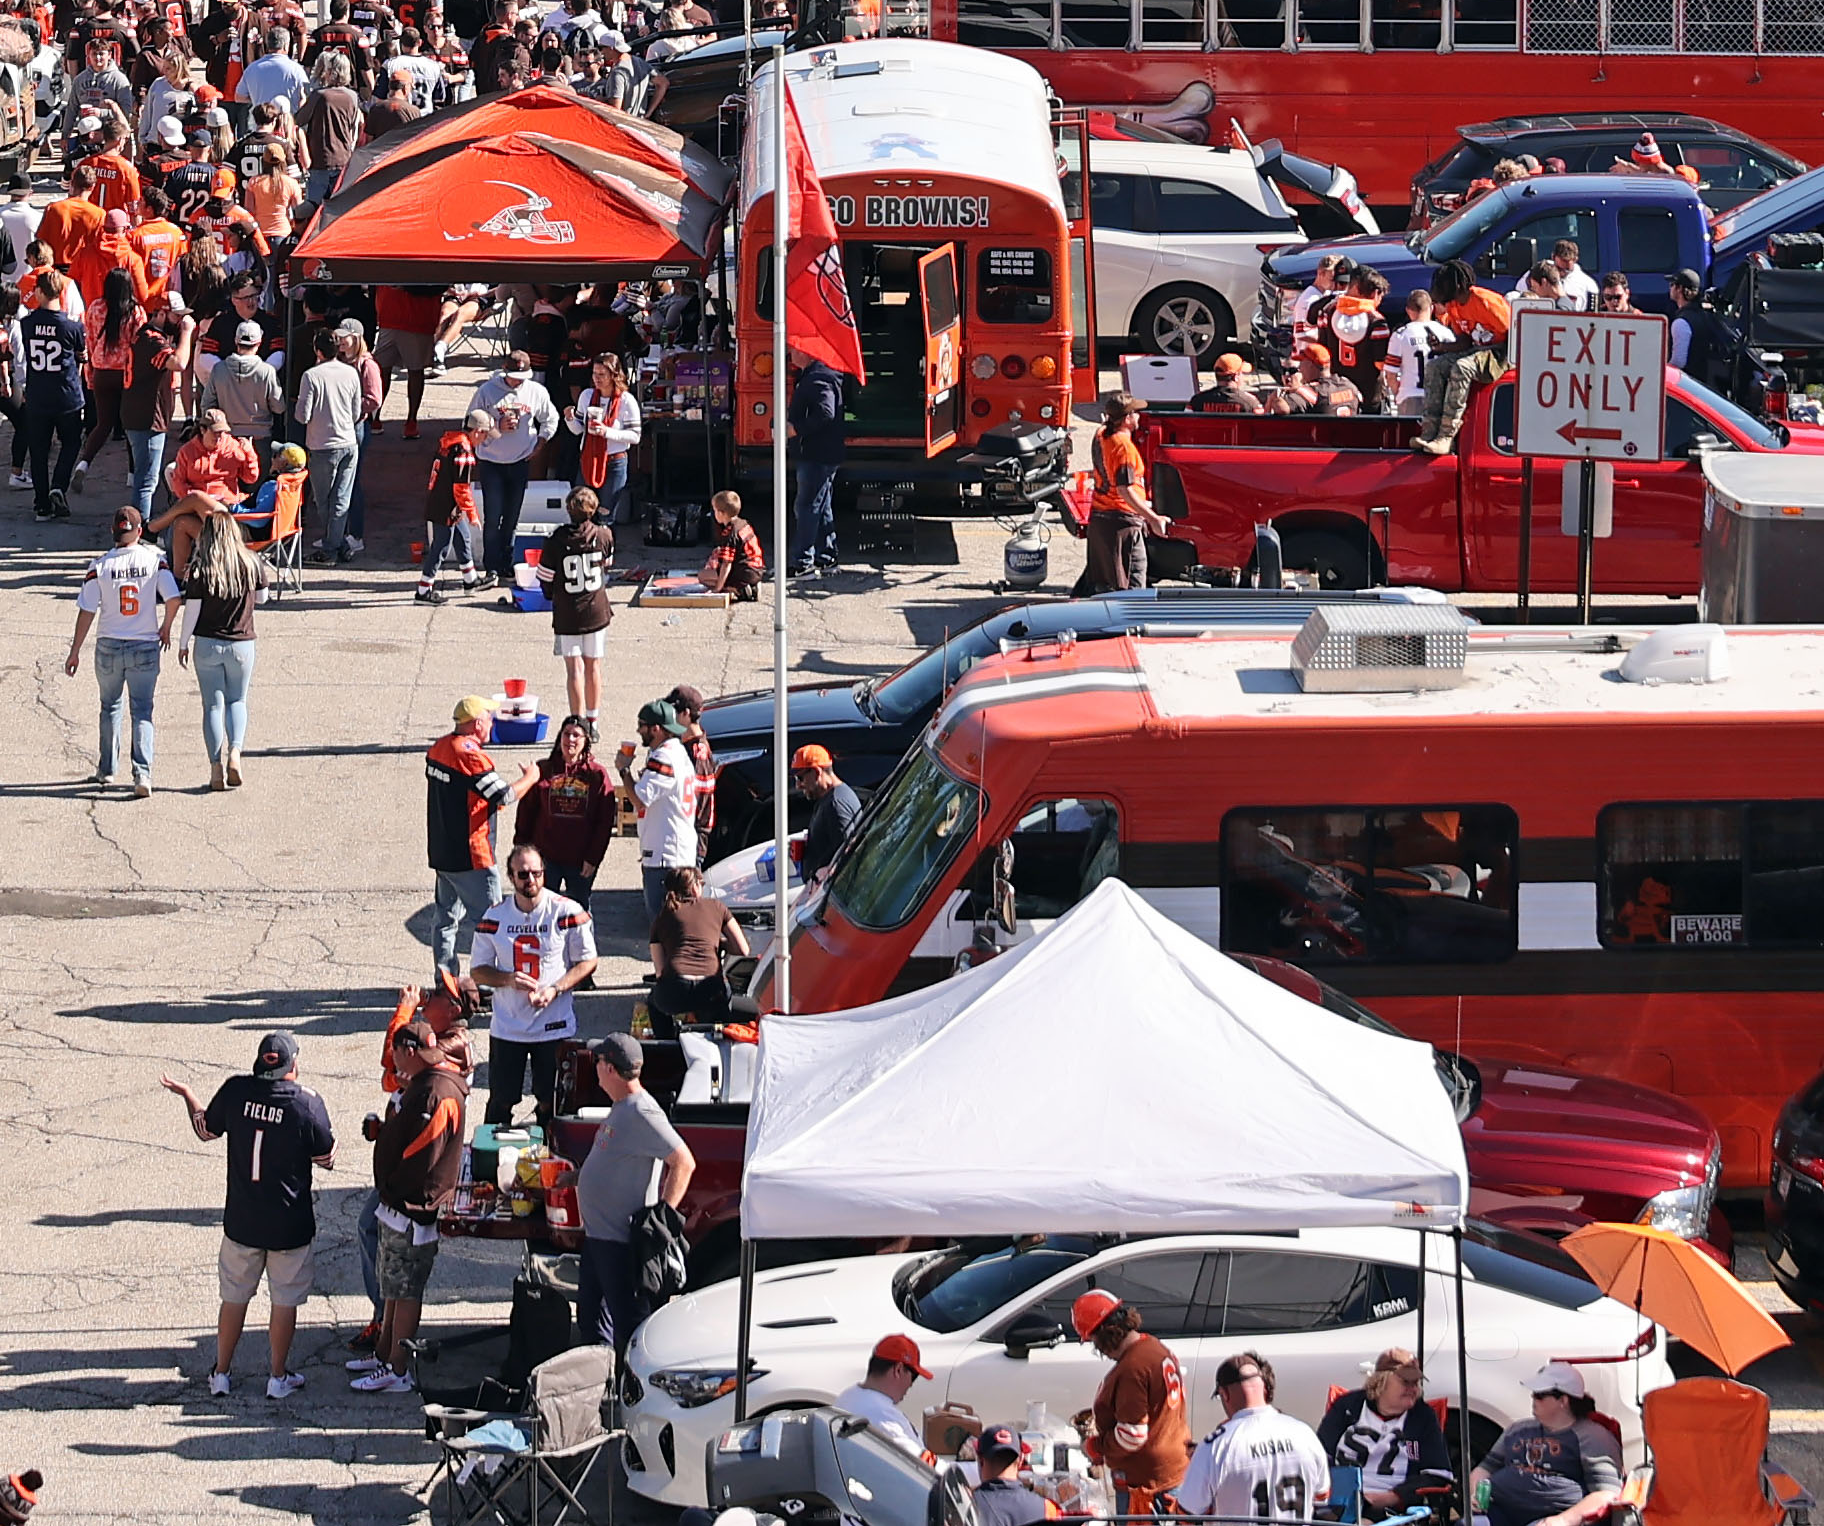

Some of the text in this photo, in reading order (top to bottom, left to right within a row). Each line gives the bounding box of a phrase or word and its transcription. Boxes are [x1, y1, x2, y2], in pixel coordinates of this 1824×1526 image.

[179, 189, 210, 223] 22
[866, 195, 990, 227] BROWNS!
[35, 325, 57, 336] MACK
[1547, 326, 1637, 365] EXIT
[29, 339, 62, 373] 52
[1338, 345, 1356, 366] 6
[1536, 372, 1644, 412] ONLY
[562, 550, 603, 595] 95
[119, 585, 139, 616] 6
[506, 923, 549, 934] CLEVELAND
[1677, 916, 1742, 930] BEWARE
[1686, 932, 1733, 942] of DOG
[512, 934, 541, 981] 6
[243, 1101, 285, 1124] FIELDS
[251, 1128, 265, 1181] 1
[1249, 1439, 1294, 1459] KOSAR
[1251, 1474, 1306, 1520] 19
